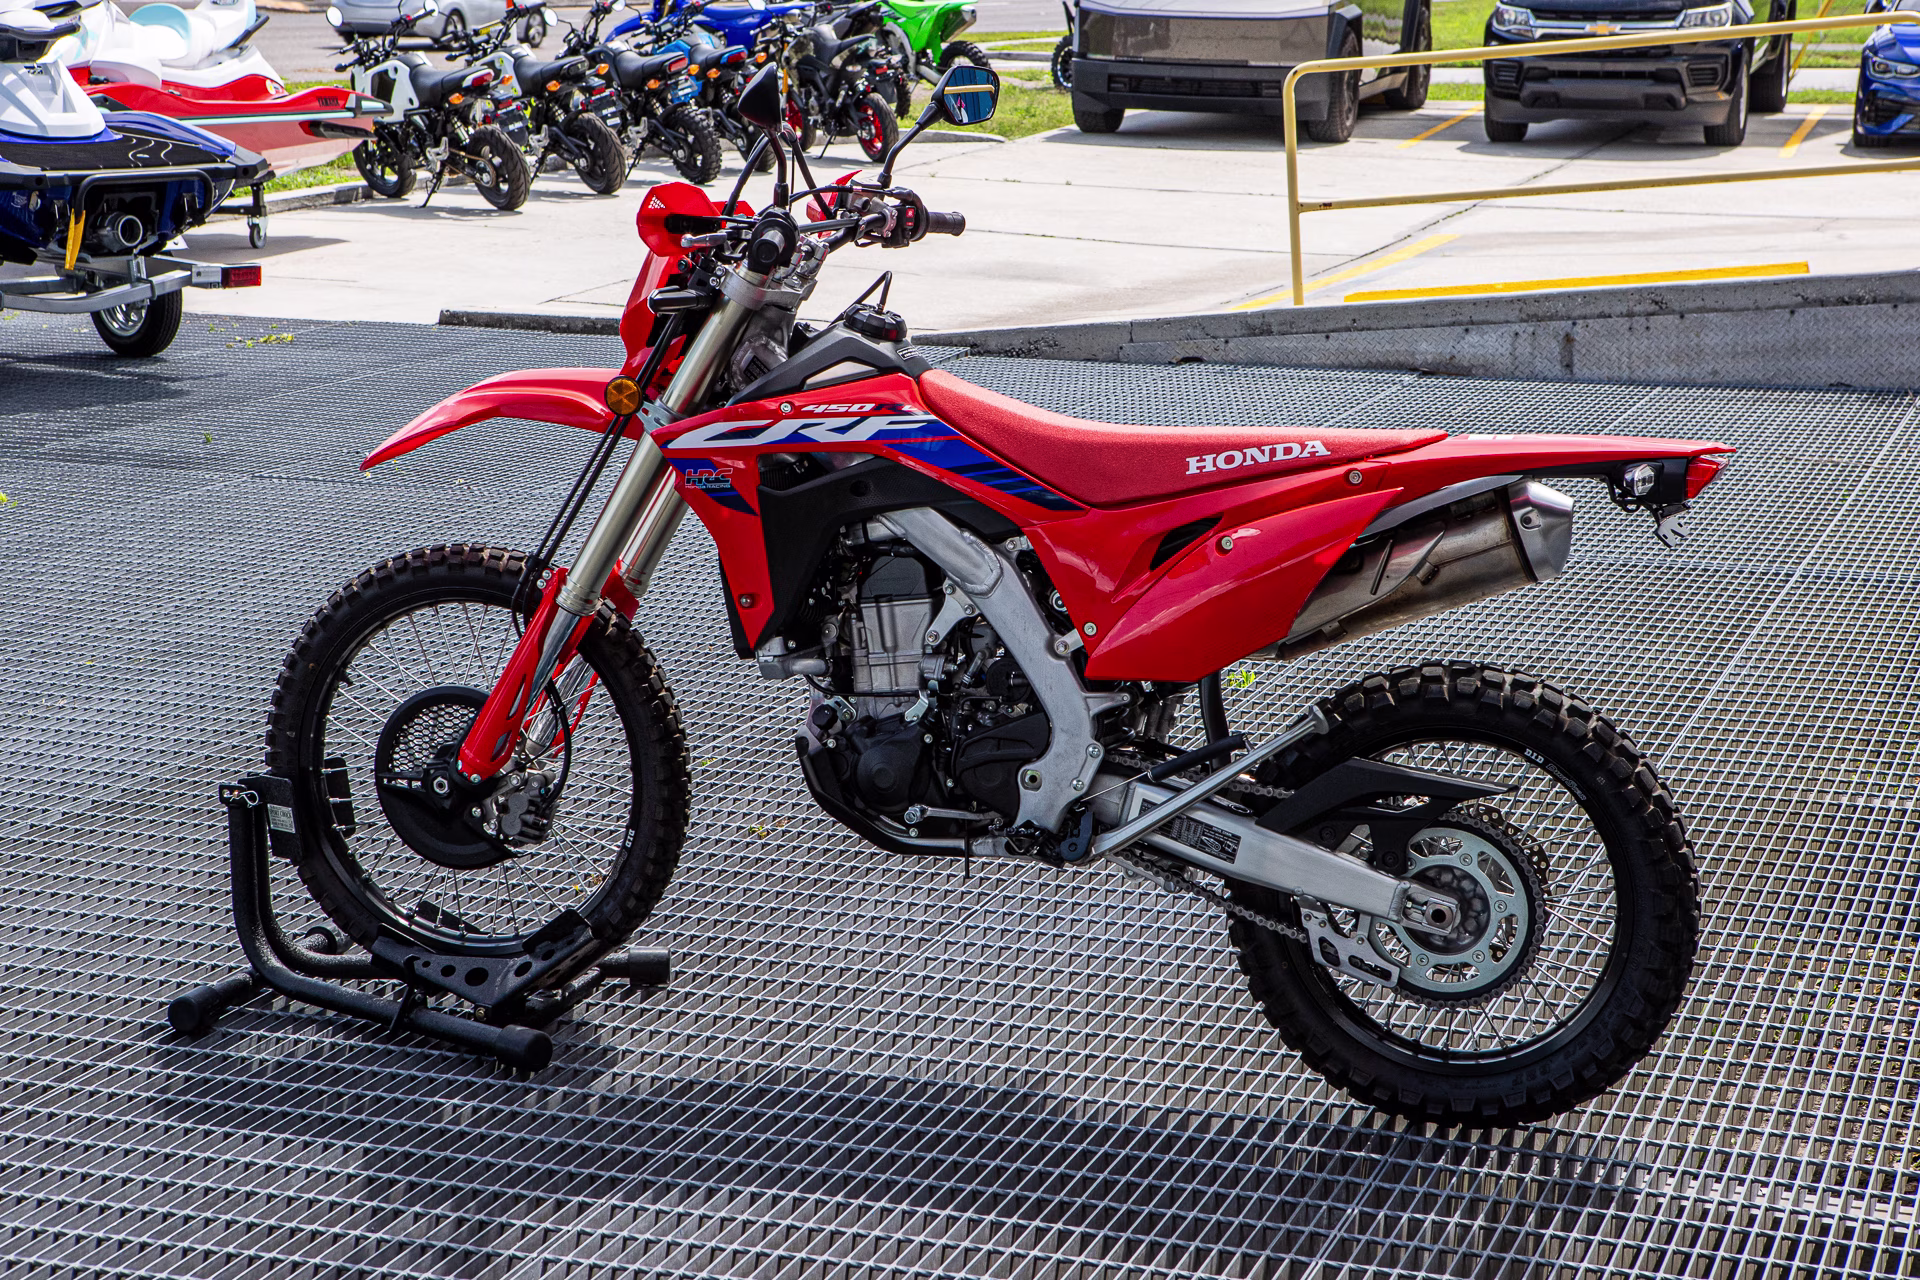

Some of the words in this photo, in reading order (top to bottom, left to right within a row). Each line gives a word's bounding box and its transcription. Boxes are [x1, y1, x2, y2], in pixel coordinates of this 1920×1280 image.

[667, 414, 937, 449] CRF
[1185, 440, 1332, 475] HONDA
[684, 467, 734, 486] HRC
